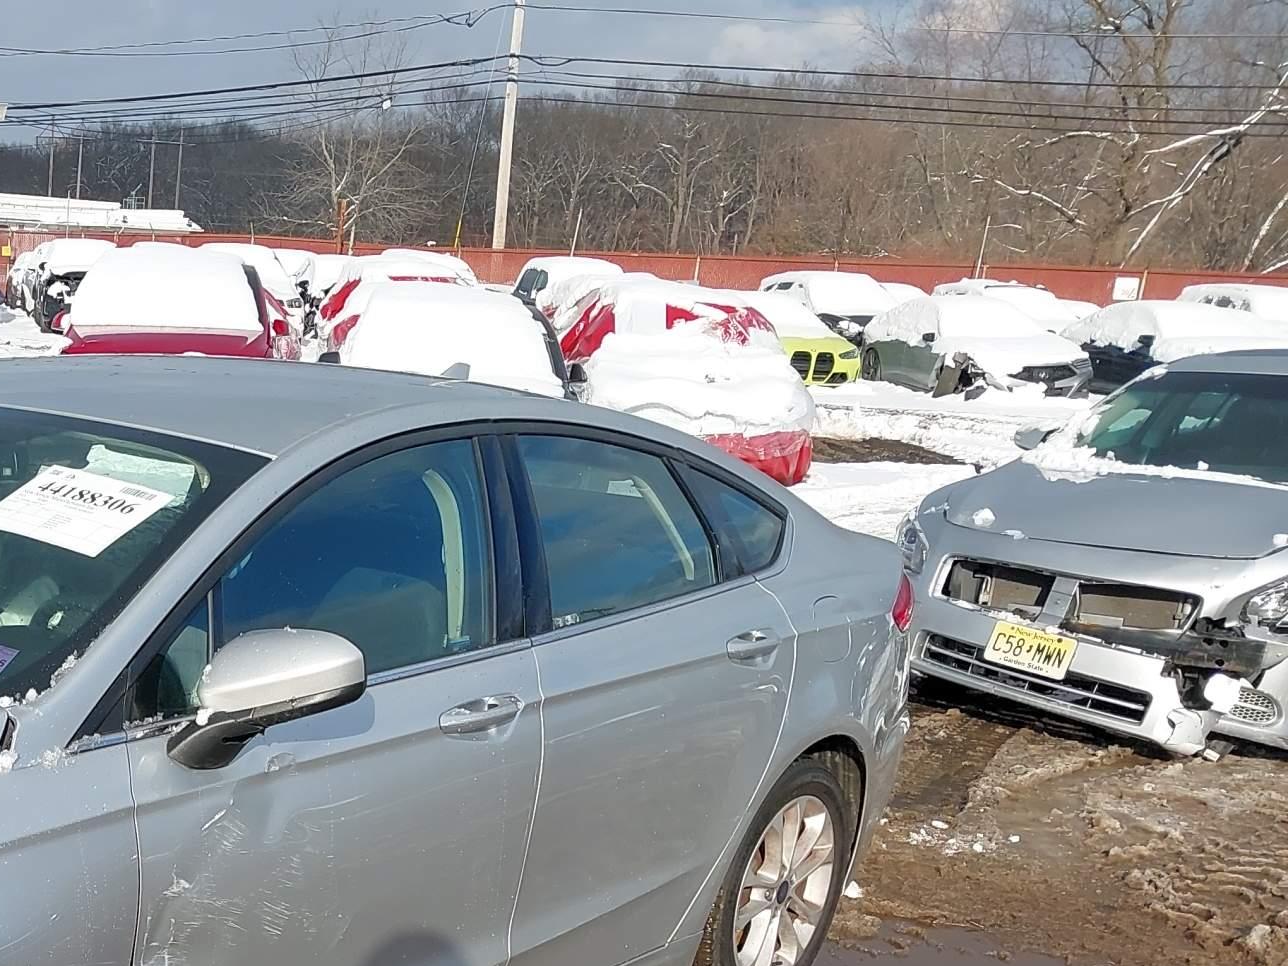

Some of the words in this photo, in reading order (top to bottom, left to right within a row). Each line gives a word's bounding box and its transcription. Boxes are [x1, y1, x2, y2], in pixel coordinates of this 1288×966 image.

[38, 481, 138, 515] 44188306
[1015, 627, 1031, 637] New
[1031, 633, 1056, 644] Jersey
[1003, 656, 1026, 667] Garden
[1026, 661, 1044, 672] State
